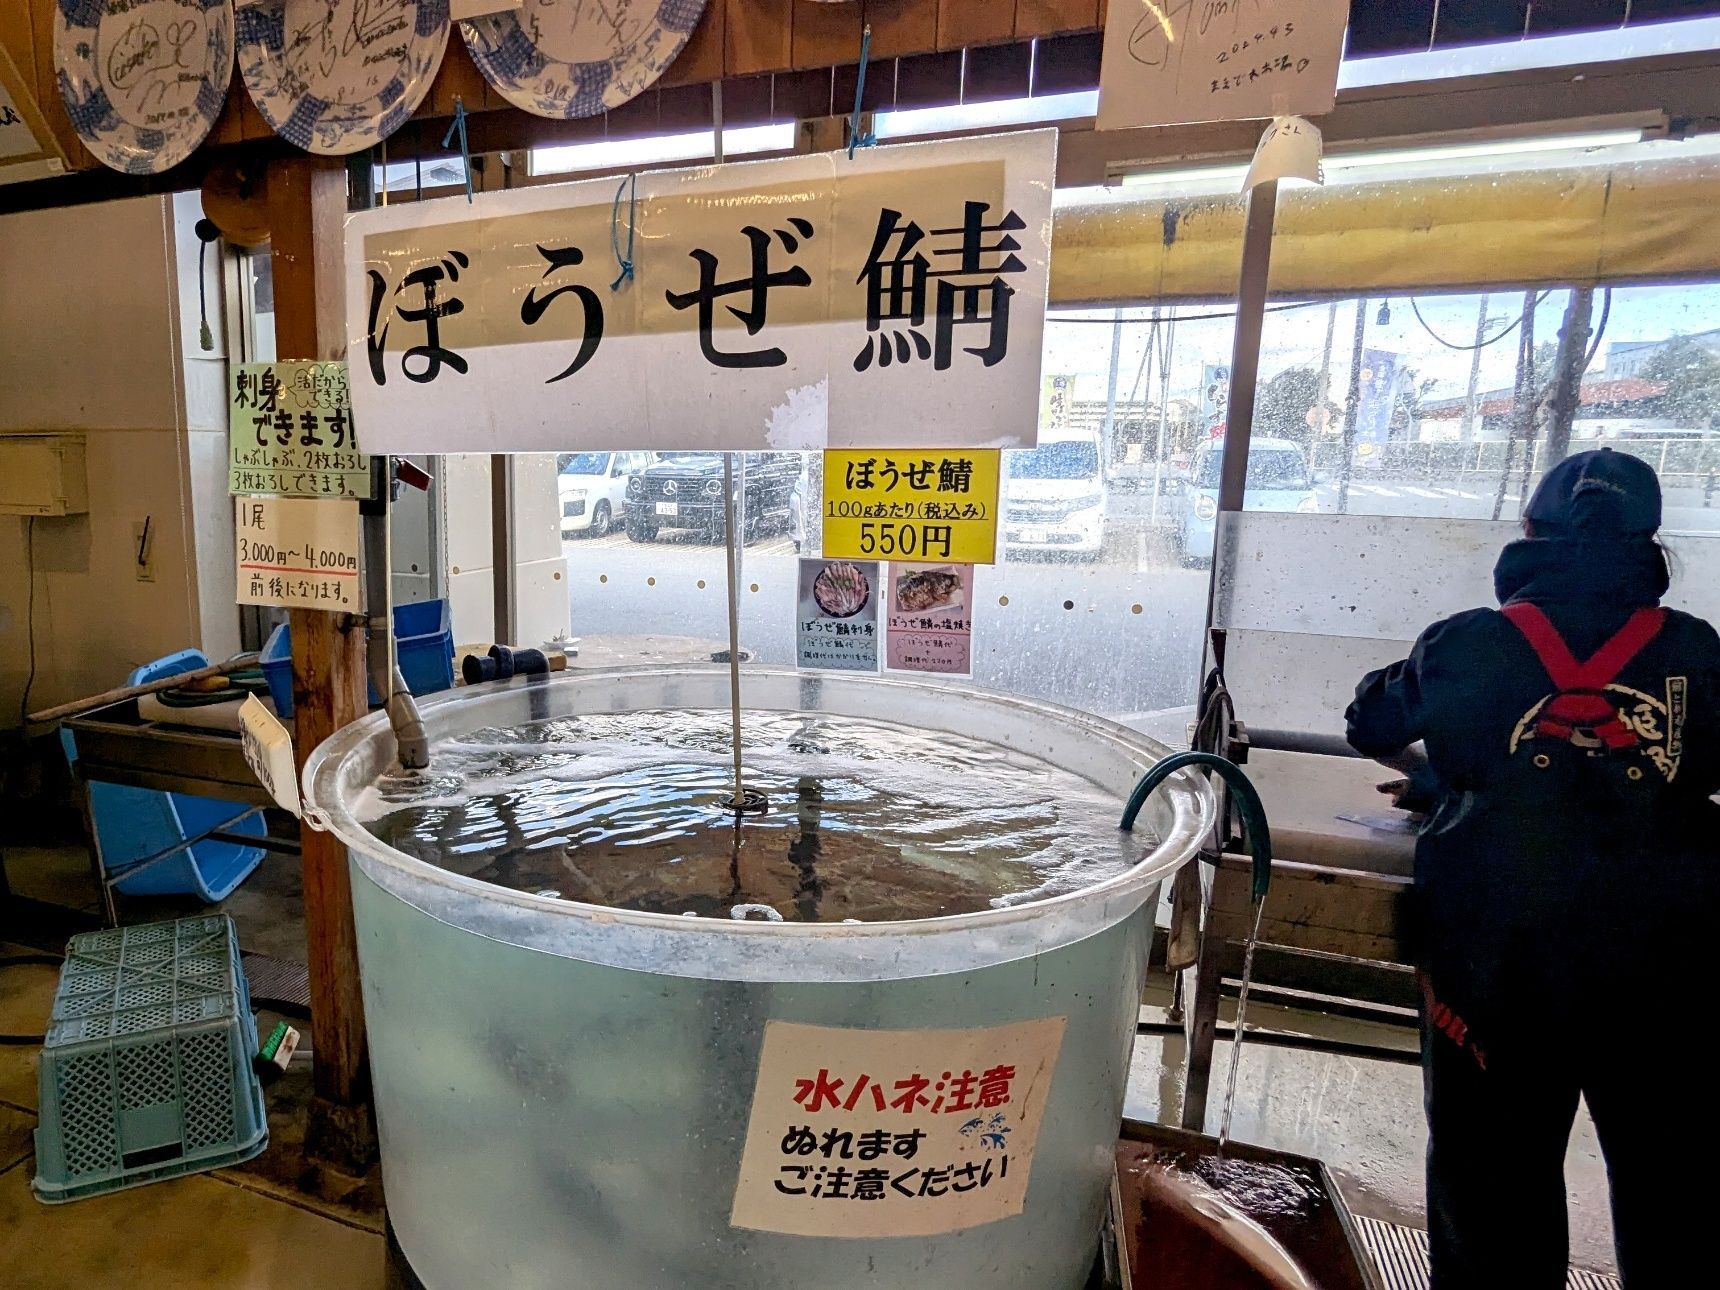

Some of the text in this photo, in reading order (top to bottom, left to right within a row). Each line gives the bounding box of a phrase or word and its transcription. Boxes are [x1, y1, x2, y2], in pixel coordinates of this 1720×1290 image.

[366, 201, 1028, 386] ぼうぜ鯖
[234, 367, 282, 412] 刺身
[297, 374, 347, 390] 活だから
[253, 409, 357, 449] できます!
[233, 470, 355, 496] 3枚おろしできます。
[846, 457, 974, 493] ぼうぜ鯖
[242, 503, 266, 530] 1尾
[860, 522, 952, 558] 550円
[250, 573, 349, 604] 前後になります。
[801, 621, 875, 637] ぼうぜ鯖刺身
[888, 616, 972, 631] ぼうぜ鯖の塩焼き
[793, 1064, 1016, 1114] 水ハネ注意
[780, 1125, 927, 1160] ぬれます
[774, 1154, 1008, 1200] ご注意ください
